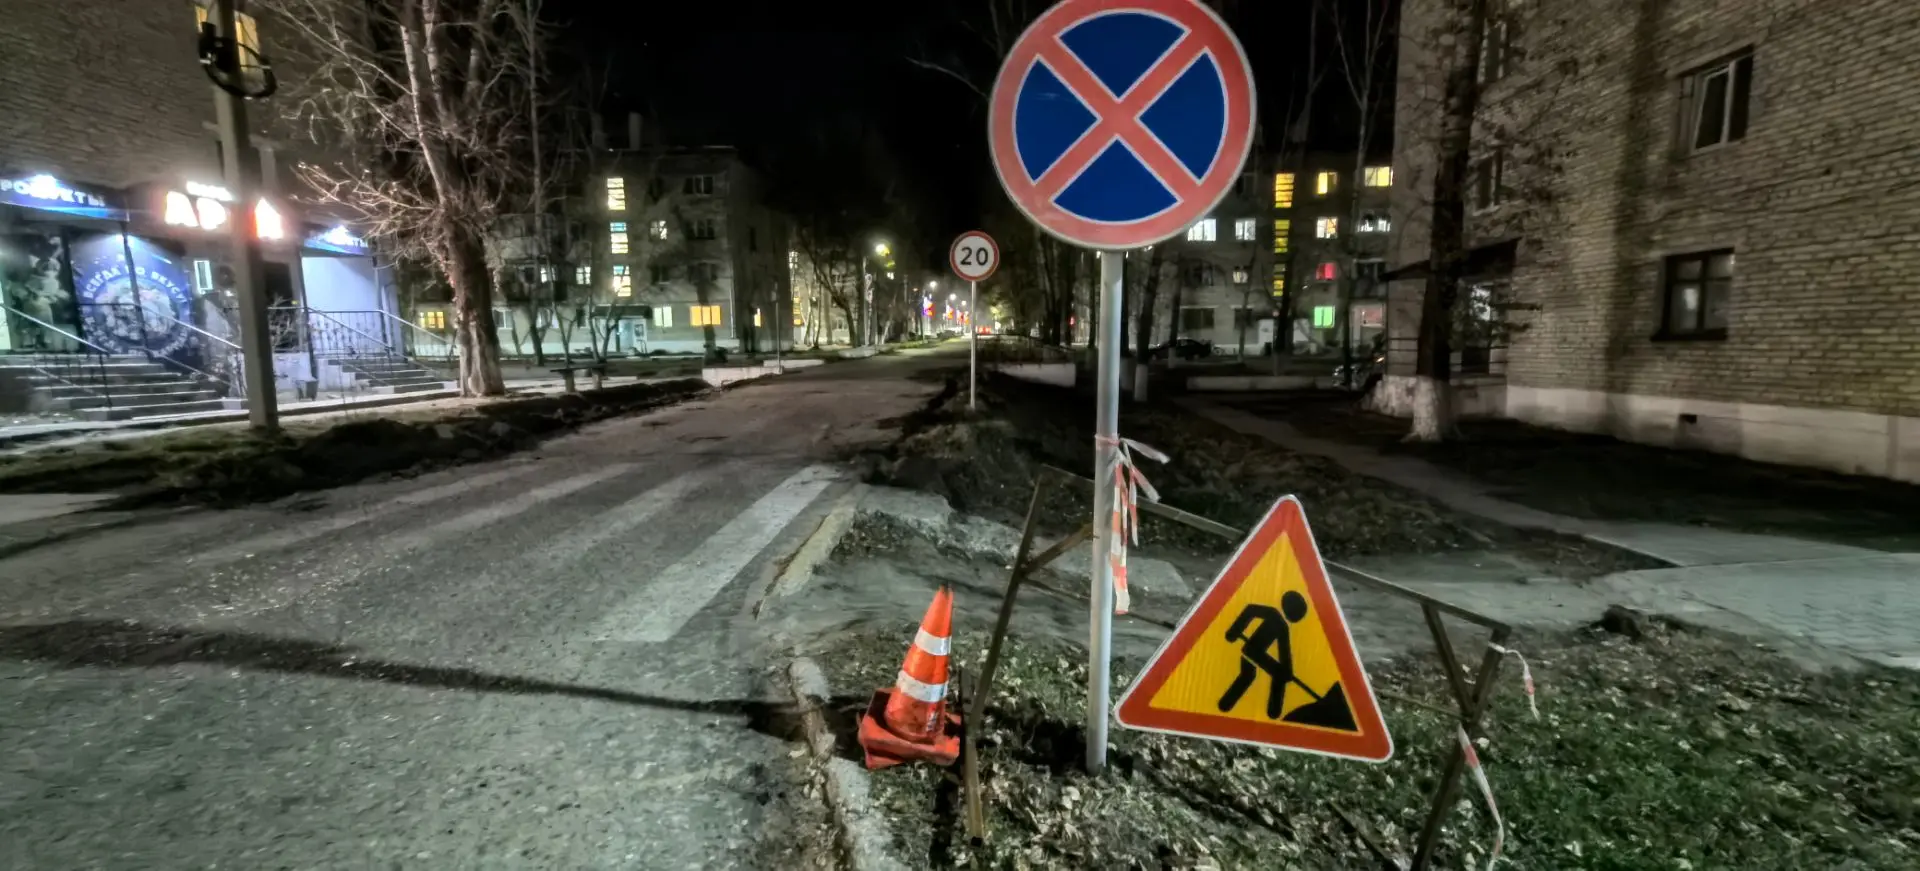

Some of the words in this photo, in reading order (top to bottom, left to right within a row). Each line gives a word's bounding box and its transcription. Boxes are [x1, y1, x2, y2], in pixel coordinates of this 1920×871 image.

[0, 175, 106, 207] РОКТЫ
[163, 190, 284, 240] АРА
[960, 246, 989, 266] 20
[83, 264, 122, 299] ВСЕГДА
